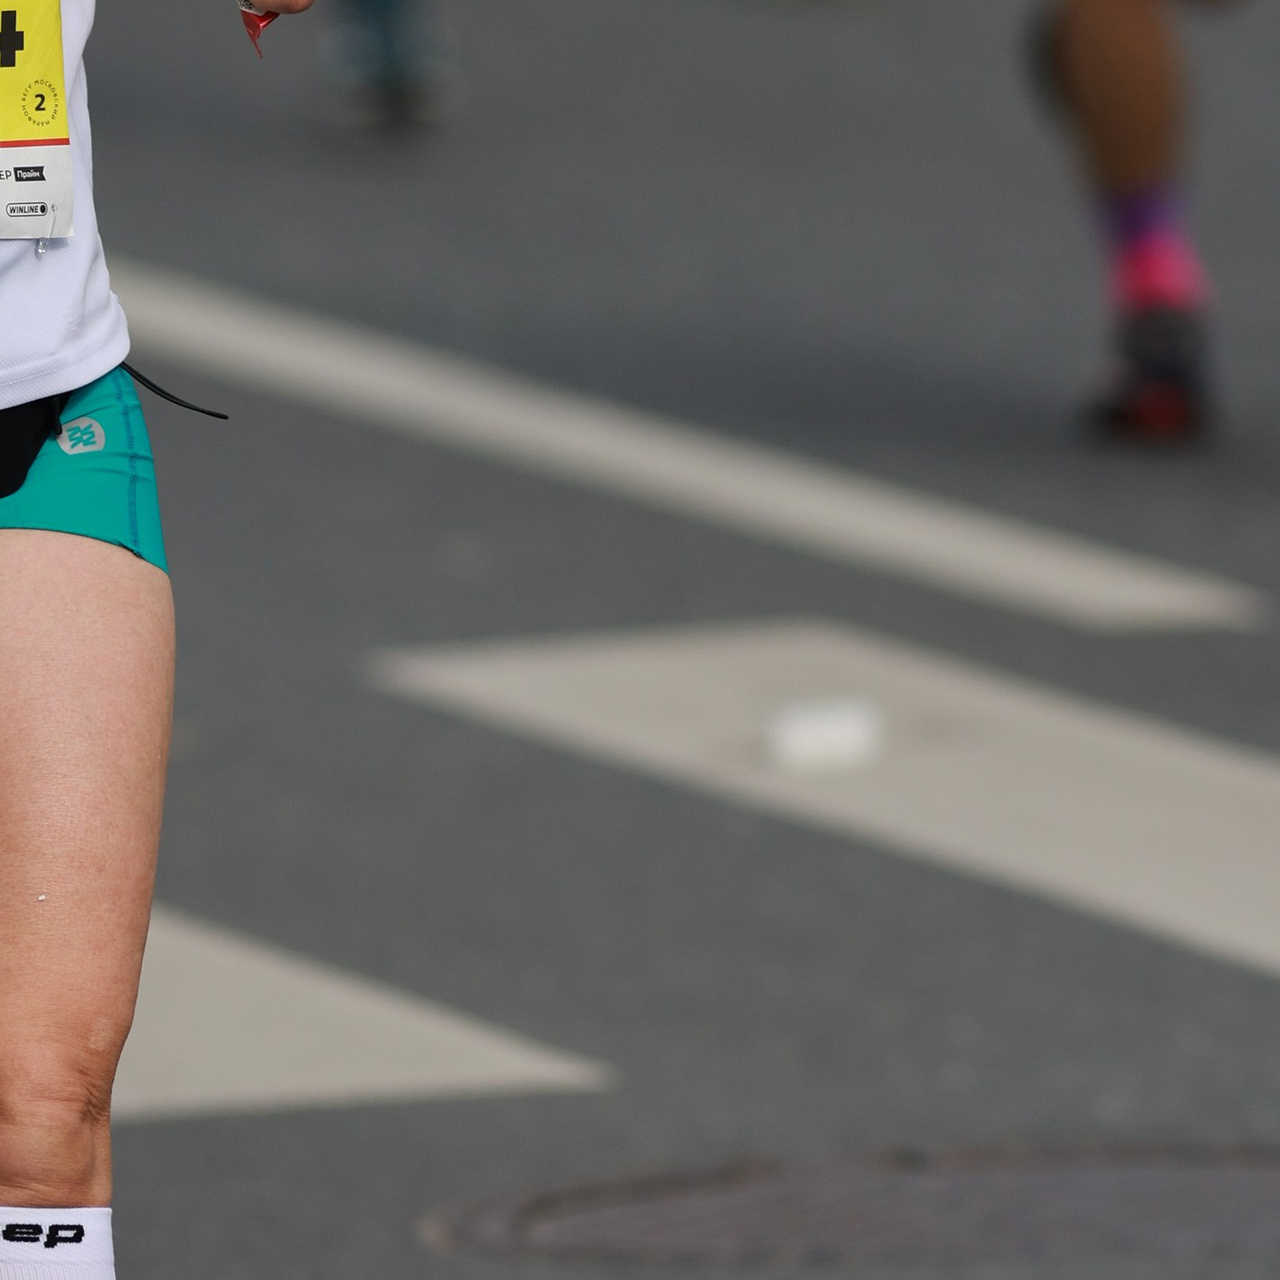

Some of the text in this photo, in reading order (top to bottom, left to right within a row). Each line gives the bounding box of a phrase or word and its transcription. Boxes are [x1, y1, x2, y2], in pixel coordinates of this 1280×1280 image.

[34, 93, 46, 112] 2
[17, 169, 41, 179] Прайм
[9, 205, 39, 214] WINLINE
